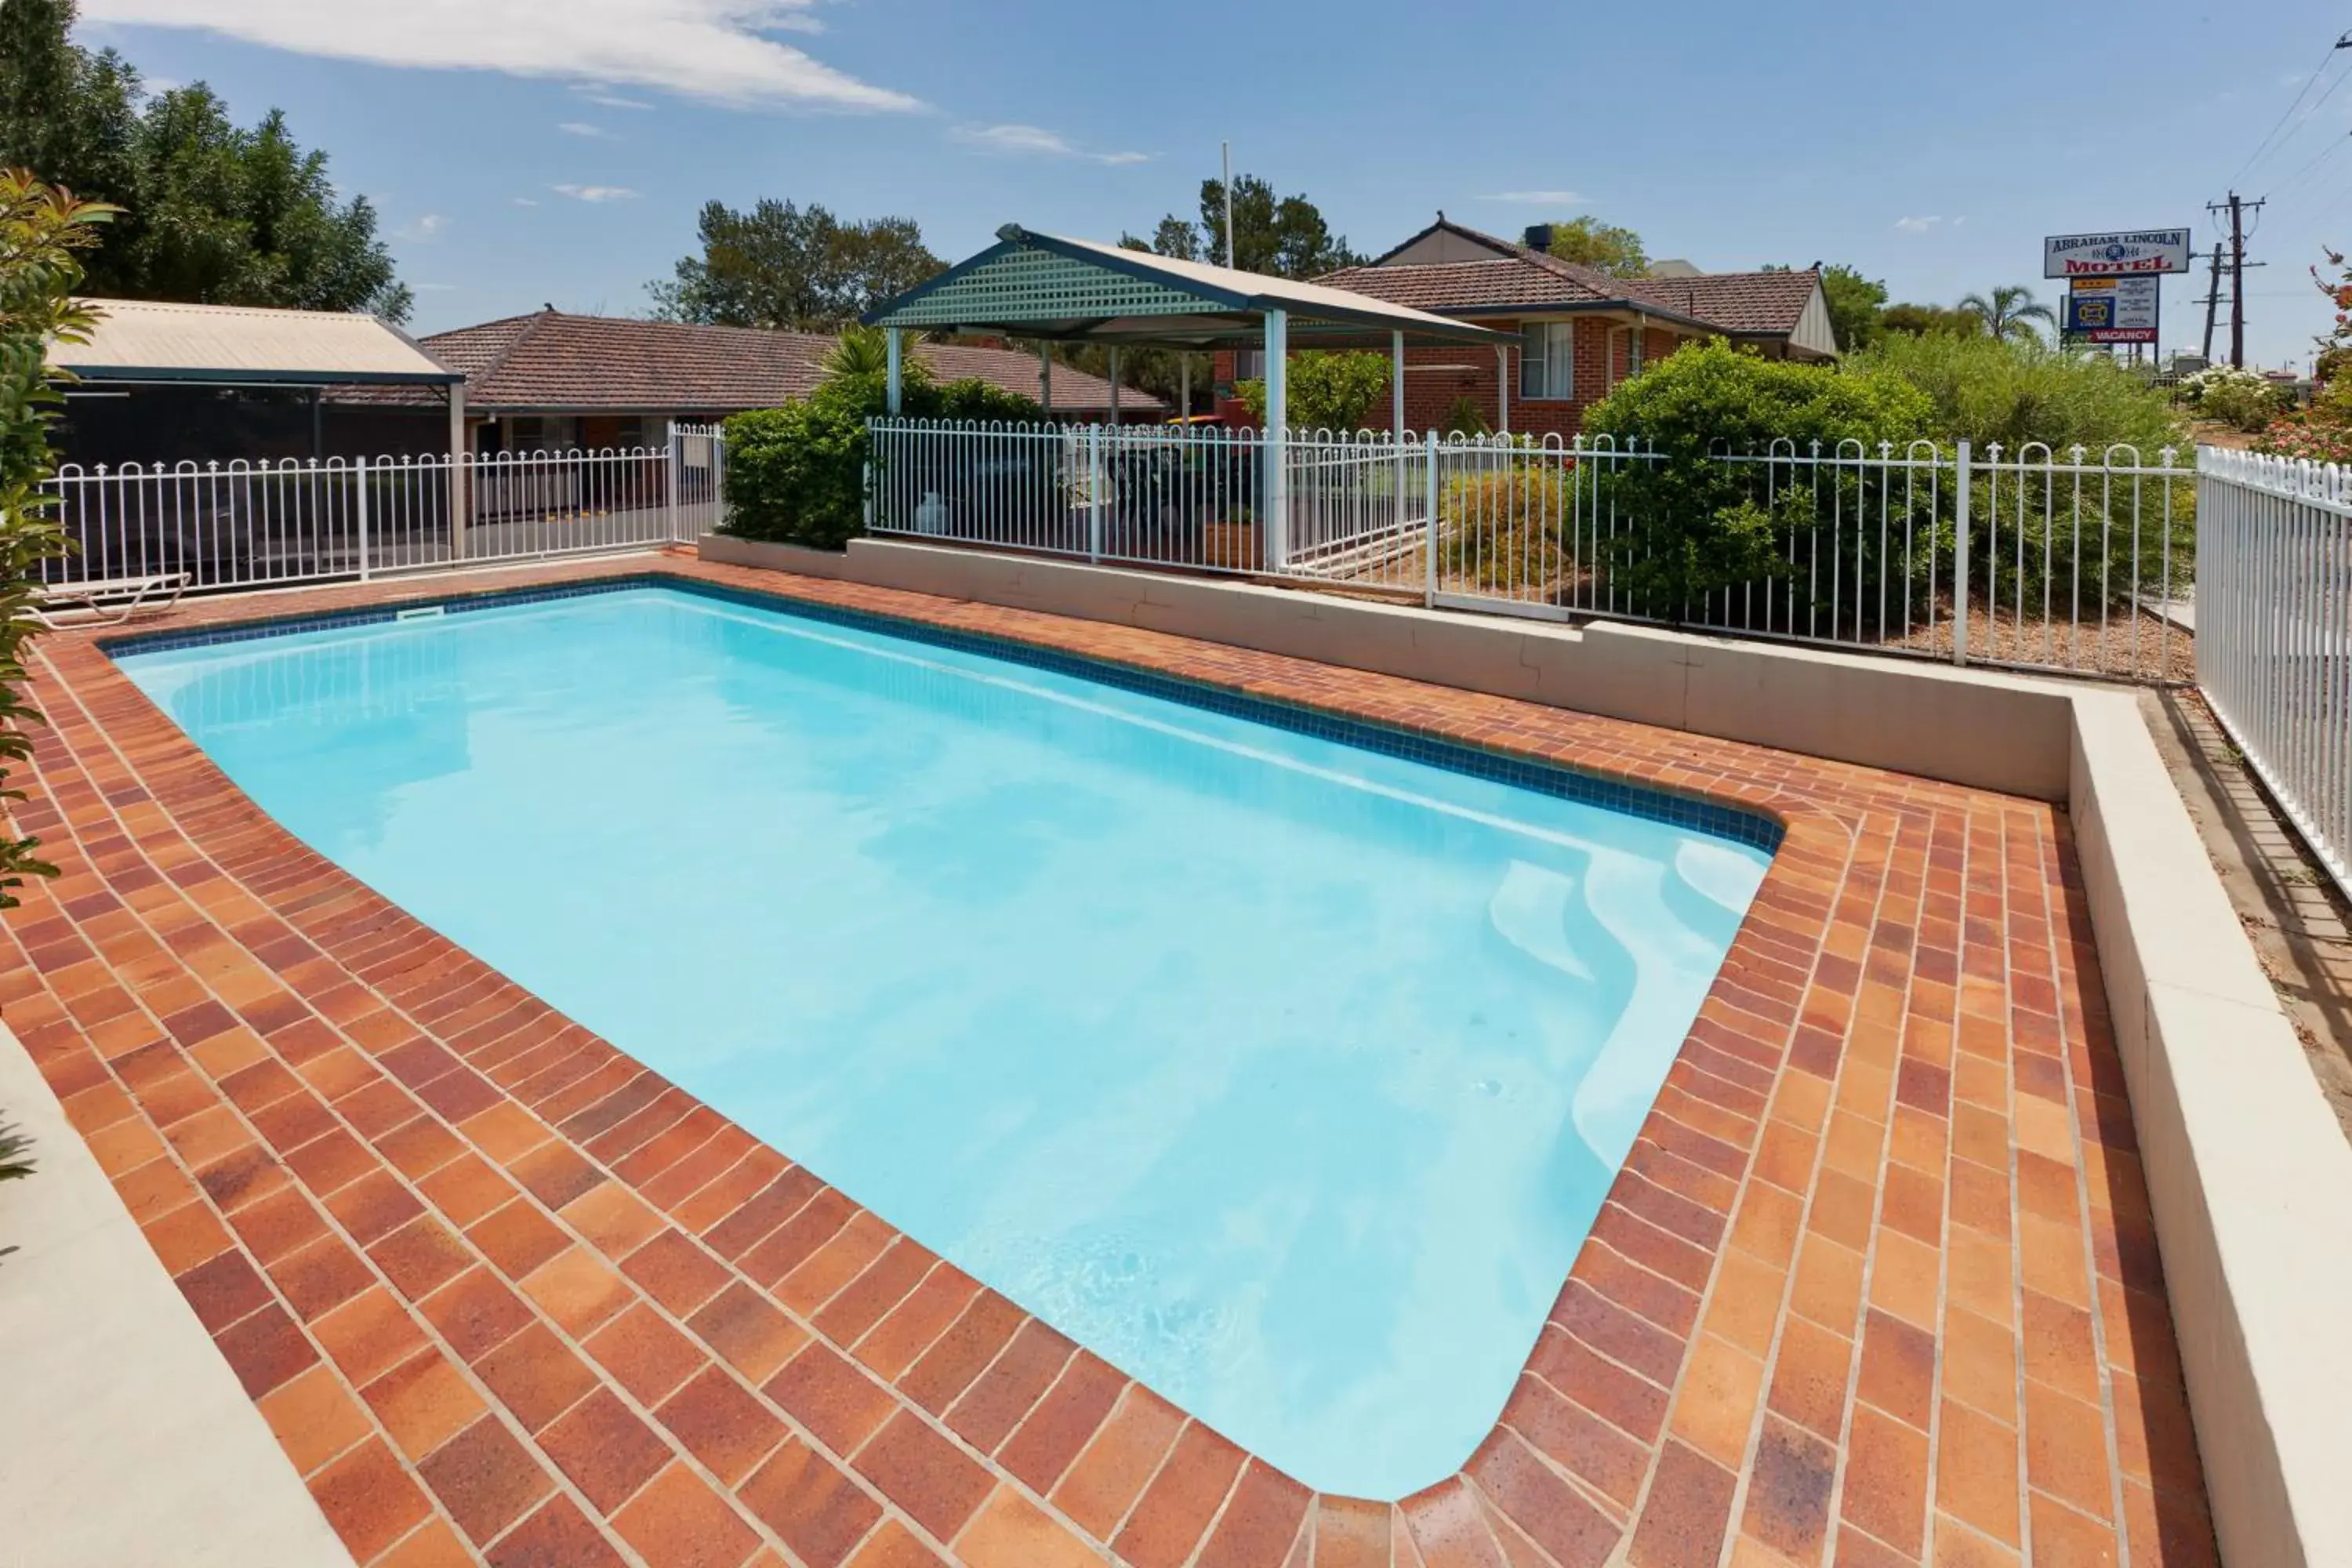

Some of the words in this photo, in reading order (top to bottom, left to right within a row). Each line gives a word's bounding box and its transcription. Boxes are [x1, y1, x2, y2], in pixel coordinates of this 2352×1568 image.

[2052, 236, 2119, 253] ABRAHAM
[2124, 232, 2180, 245] LINCOLN
[2065, 255, 2172, 273] MOTEL
[2096, 331, 2151, 339] VACANCY
